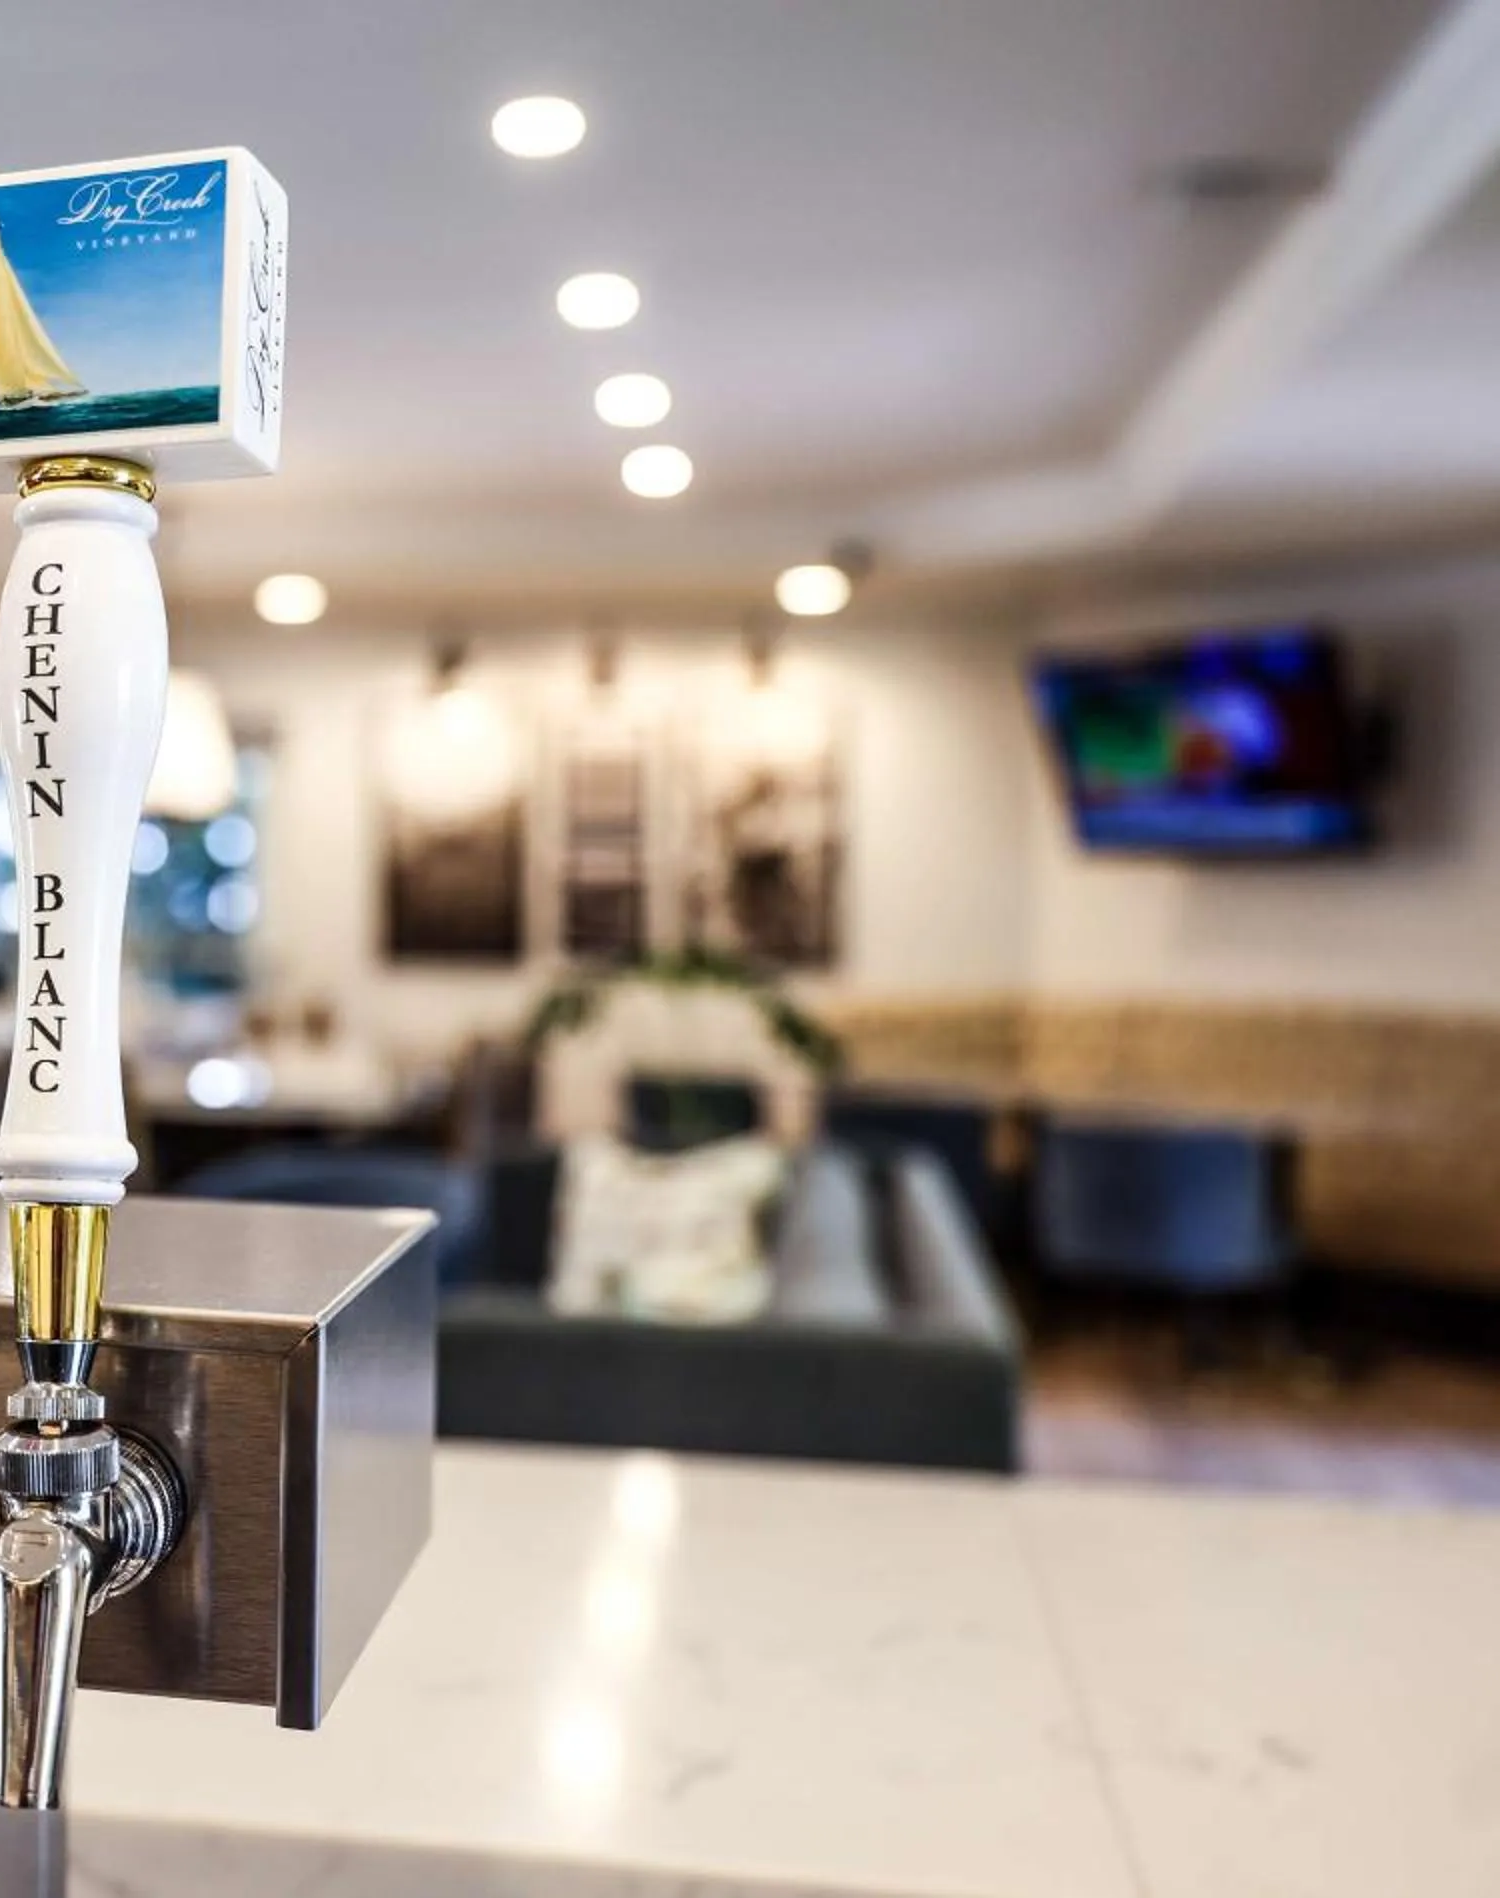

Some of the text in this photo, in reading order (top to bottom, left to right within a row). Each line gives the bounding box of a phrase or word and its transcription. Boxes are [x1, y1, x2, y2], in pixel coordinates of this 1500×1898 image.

[56, 171, 222, 233] Dry Creek
[75, 228, 197, 251] VINEYARD
[21, 563, 67, 1093] CHENIN BLANC
